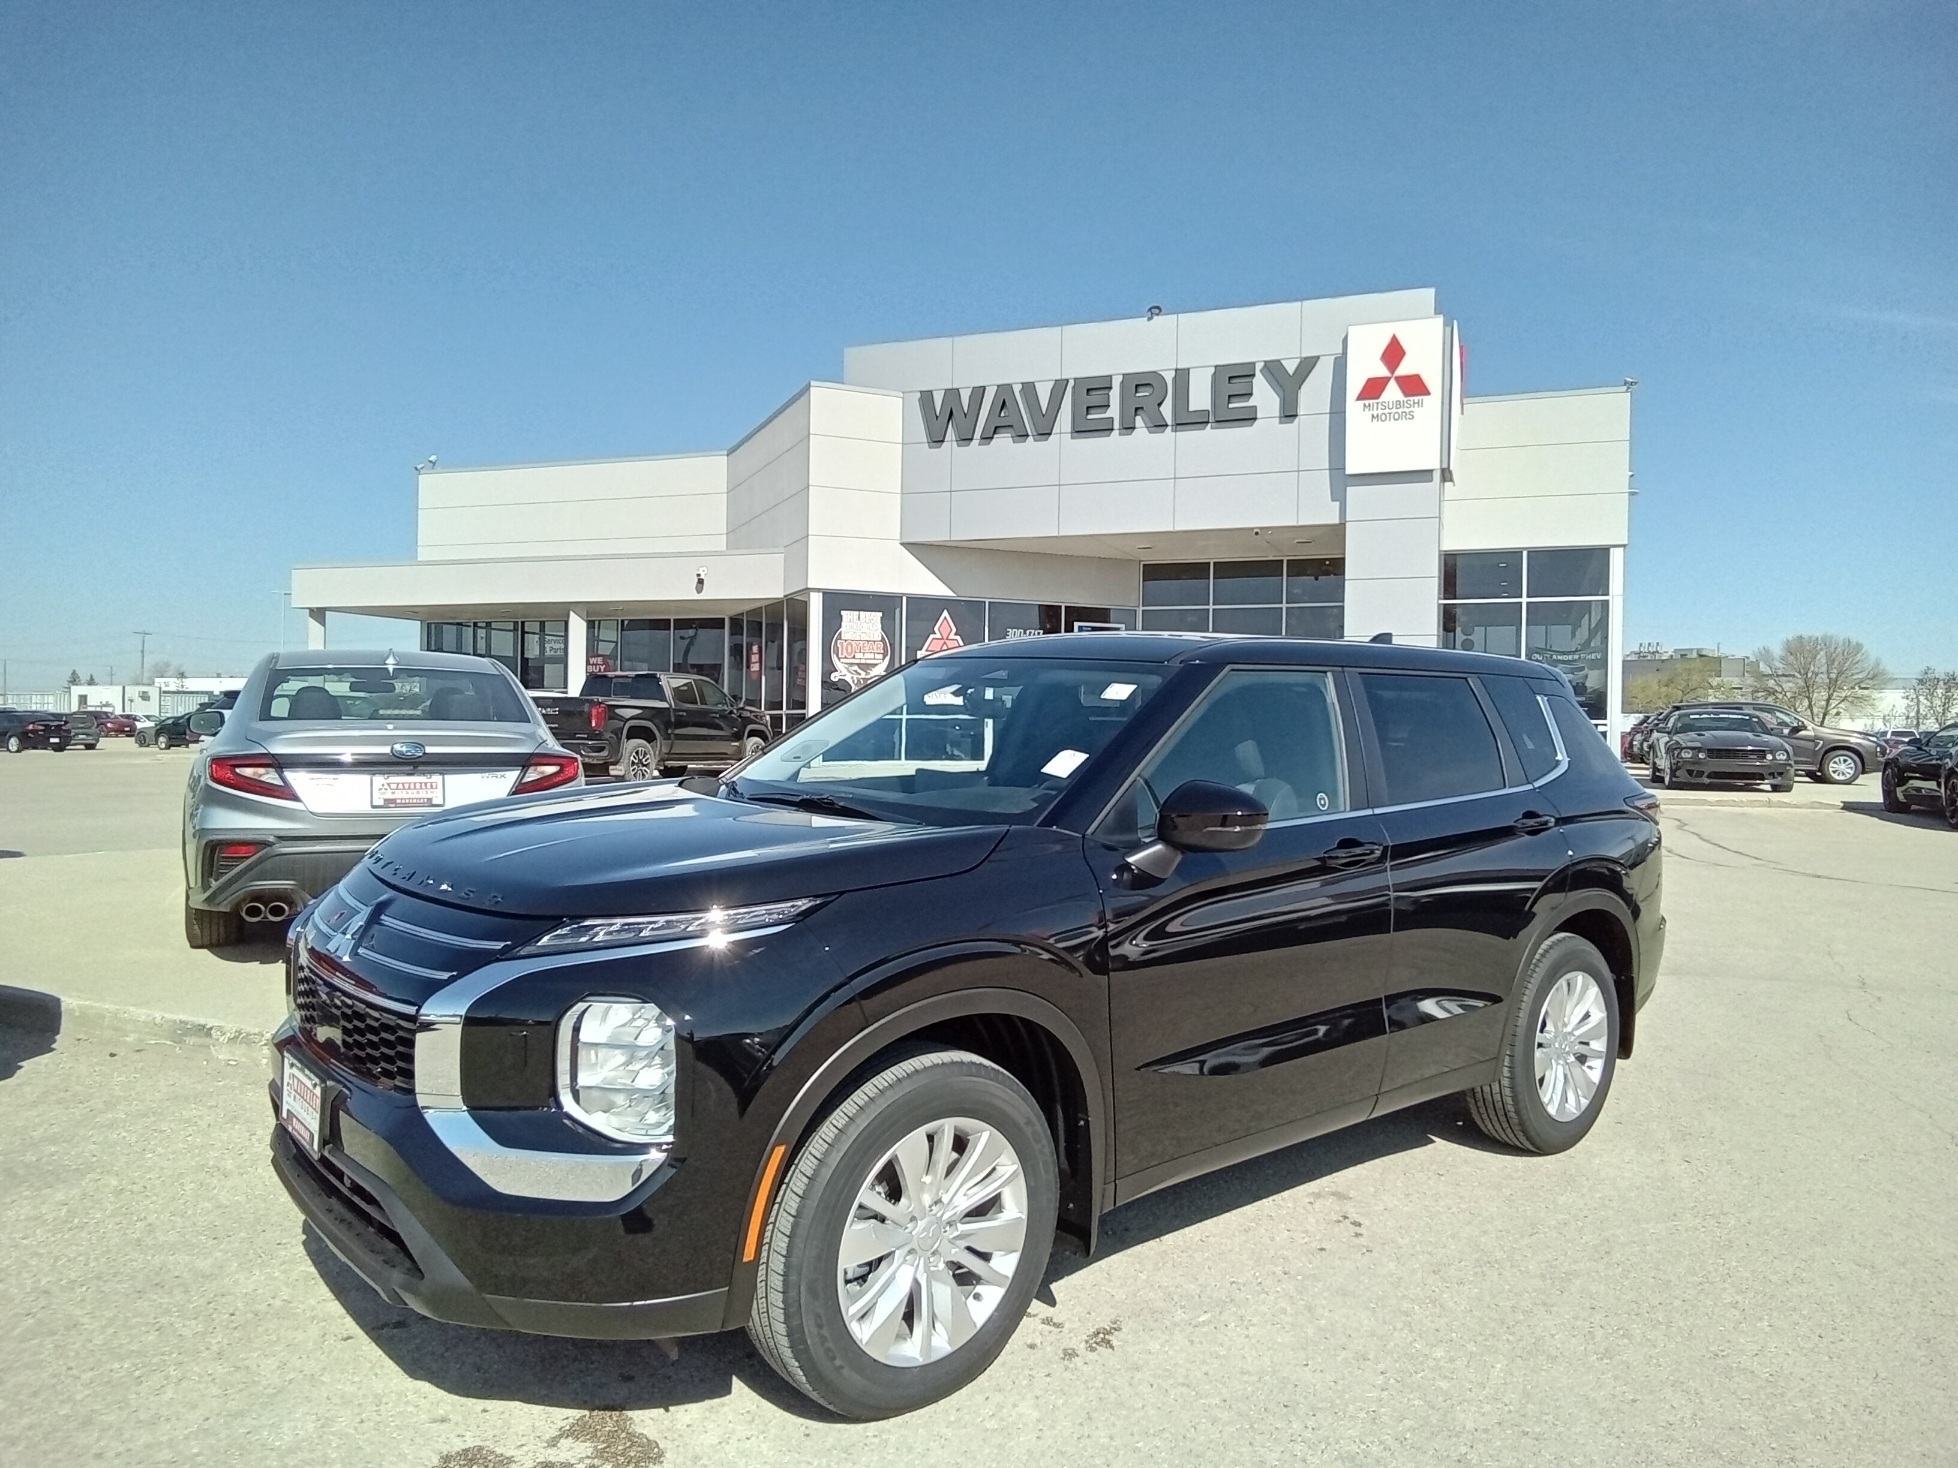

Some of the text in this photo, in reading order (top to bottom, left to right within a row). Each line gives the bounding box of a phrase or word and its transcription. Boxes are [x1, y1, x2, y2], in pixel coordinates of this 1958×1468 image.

[919, 356, 1320, 447] WAVERLEY
[1363, 399, 1424, 412] MITSUBISHI
[1371, 411, 1415, 423] MOTORS
[838, 640, 884, 658] 10 YEAR
[589, 656, 604, 664] WE
[390, 782, 437, 790] WAVERLEY
